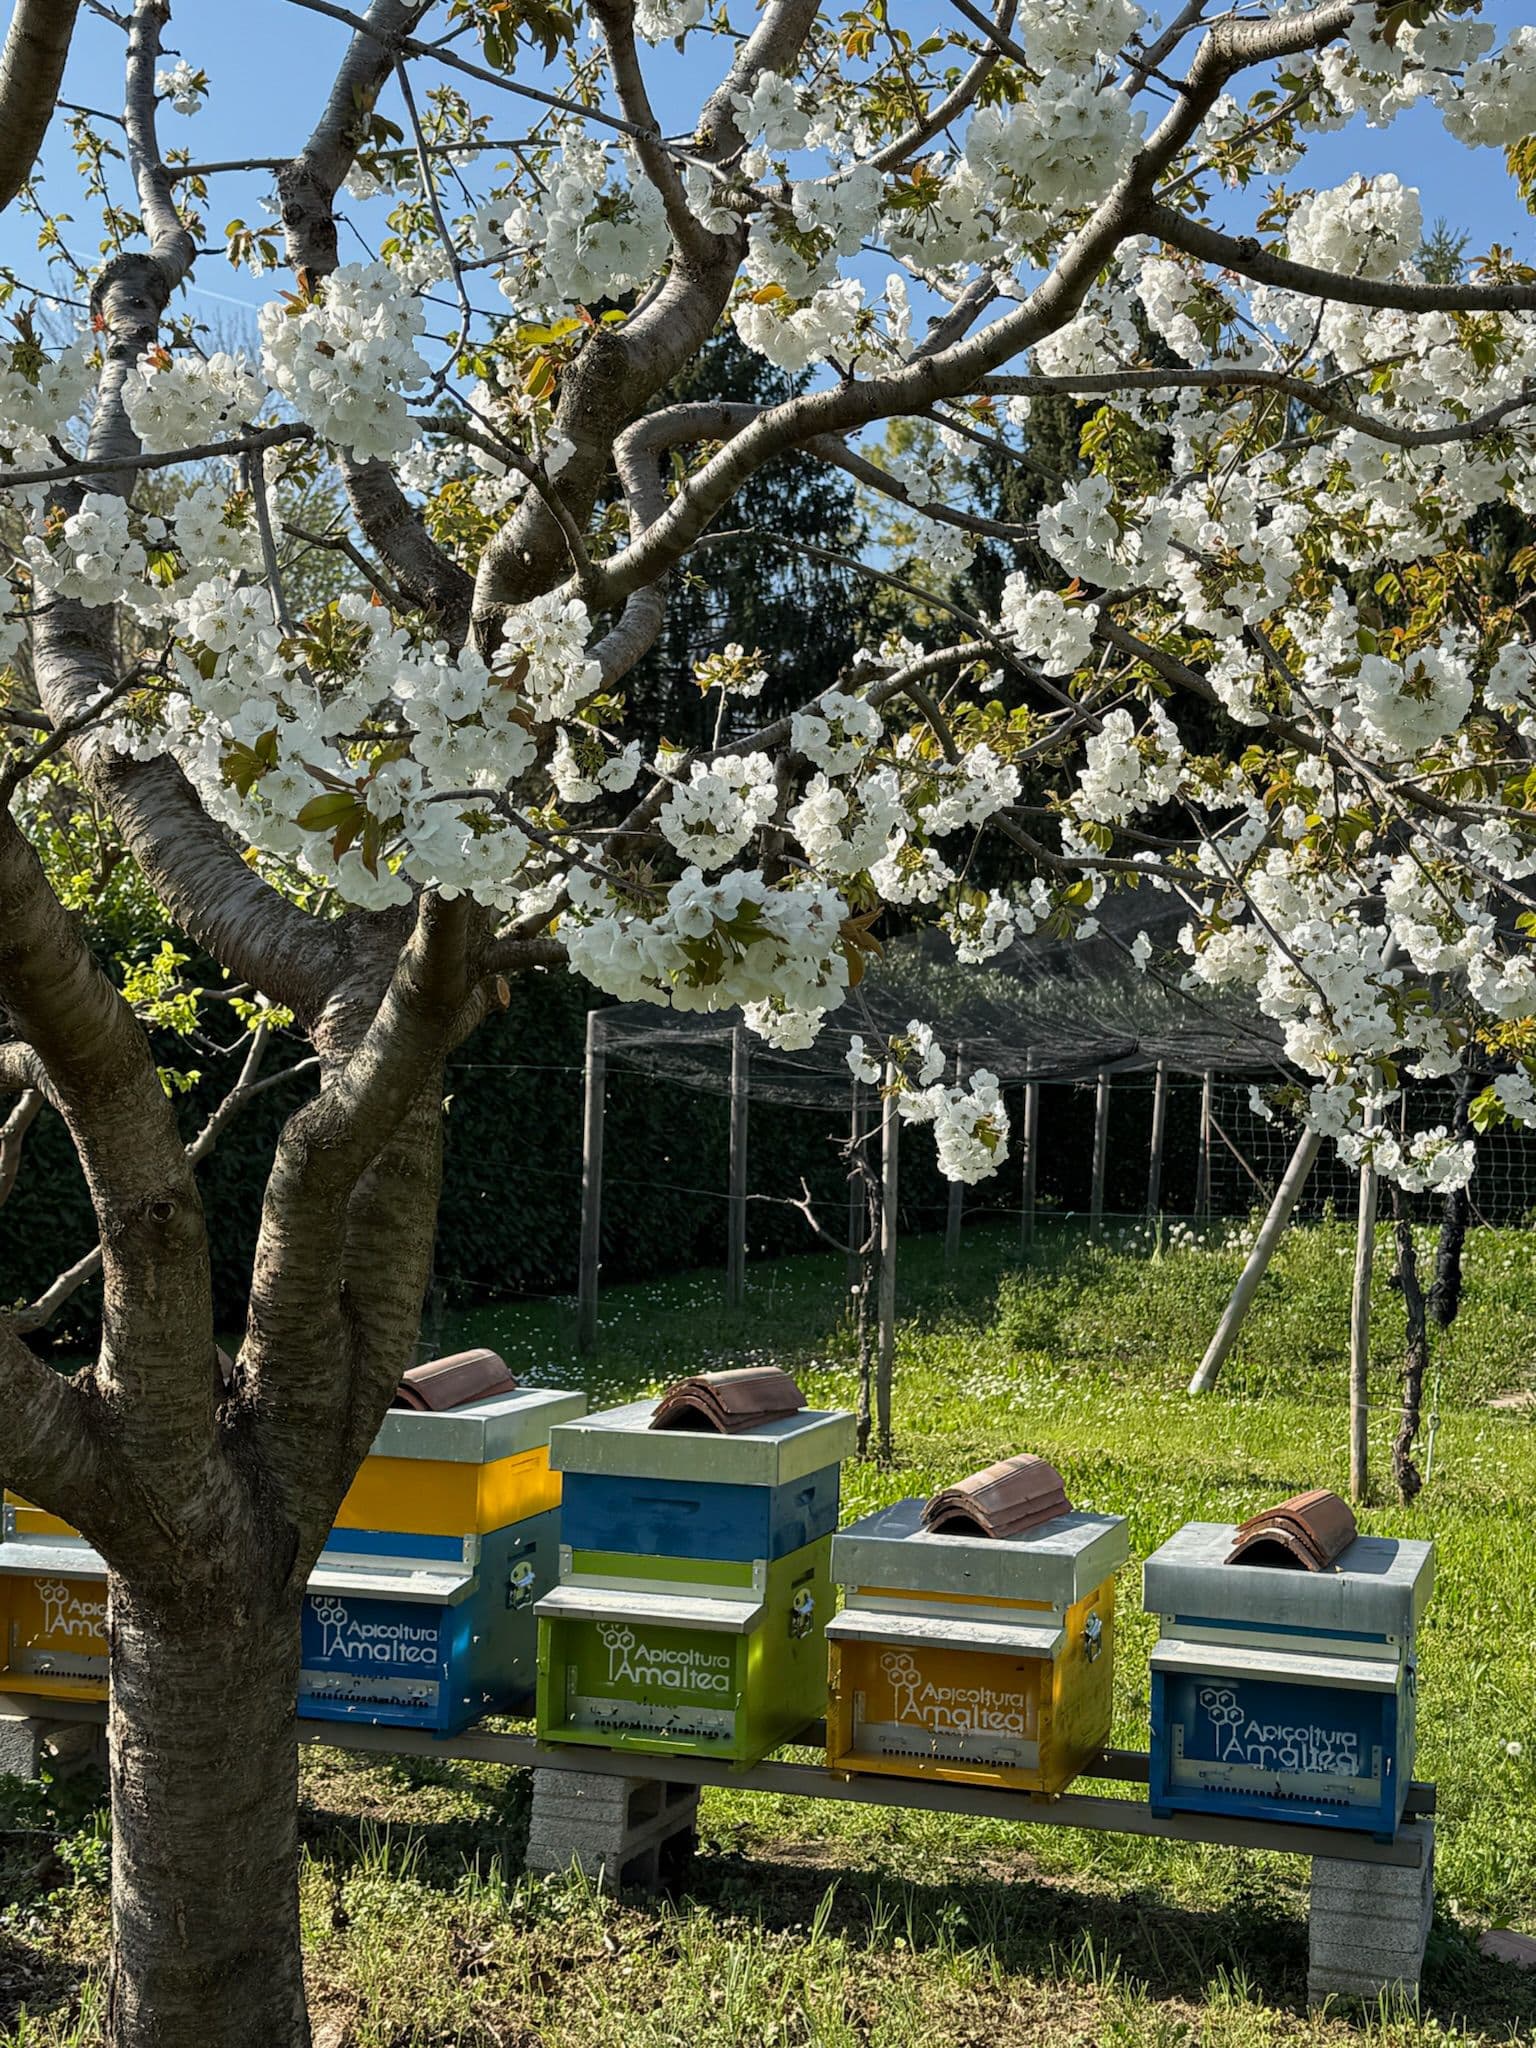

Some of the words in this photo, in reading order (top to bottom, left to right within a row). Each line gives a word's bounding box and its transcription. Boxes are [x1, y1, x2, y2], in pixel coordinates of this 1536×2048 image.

[347, 1620, 438, 1642] Apicoltura
[327, 1636, 437, 1664] Amaltea
[634, 1644, 730, 1668] Apicoltura
[614, 1660, 730, 1691] Amaltea
[920, 1682, 1024, 1708] Apicoltura
[900, 1699, 1024, 1732] Amaltea
[1244, 1720, 1357, 1747] Apicoltura
[1223, 1735, 1358, 1775] Amaltea
